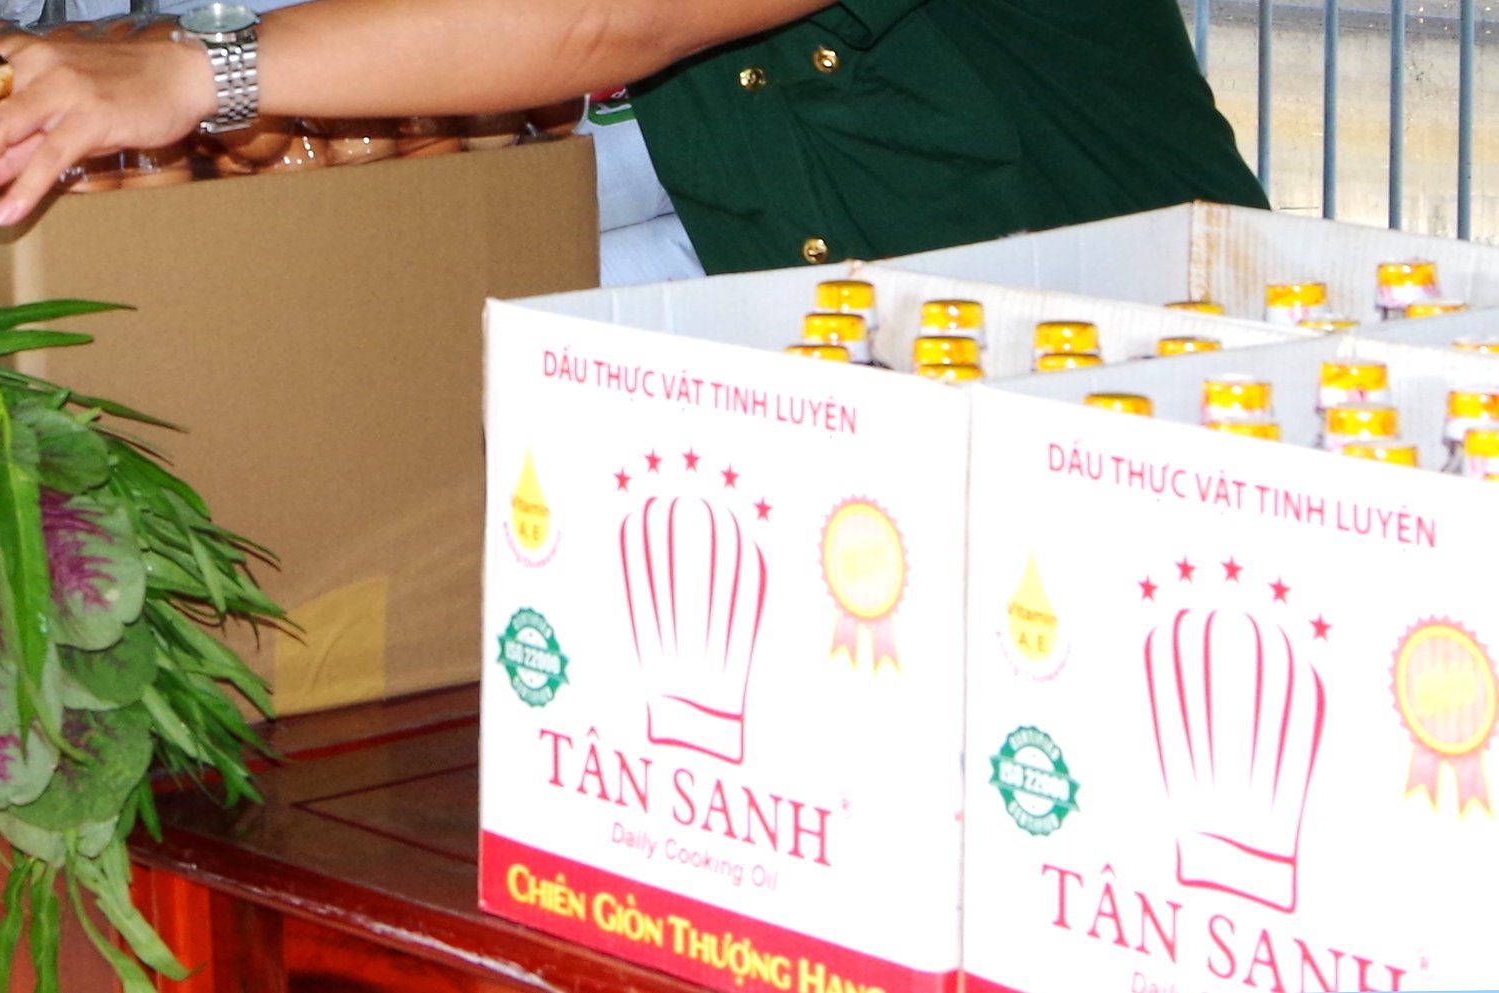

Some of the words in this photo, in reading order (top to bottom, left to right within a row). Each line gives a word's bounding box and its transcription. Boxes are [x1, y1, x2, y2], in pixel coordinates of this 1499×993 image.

[710, 381, 767, 419] TINH
[1254, 483, 1326, 526] TINH
[539, 726, 653, 814] TÂN
[672, 765, 832, 867] SANH
[611, 821, 658, 859] Daily
[665, 838, 744, 888] Cooking
[751, 863, 779, 892] Oil
[1041, 863, 1183, 964] TÂN
